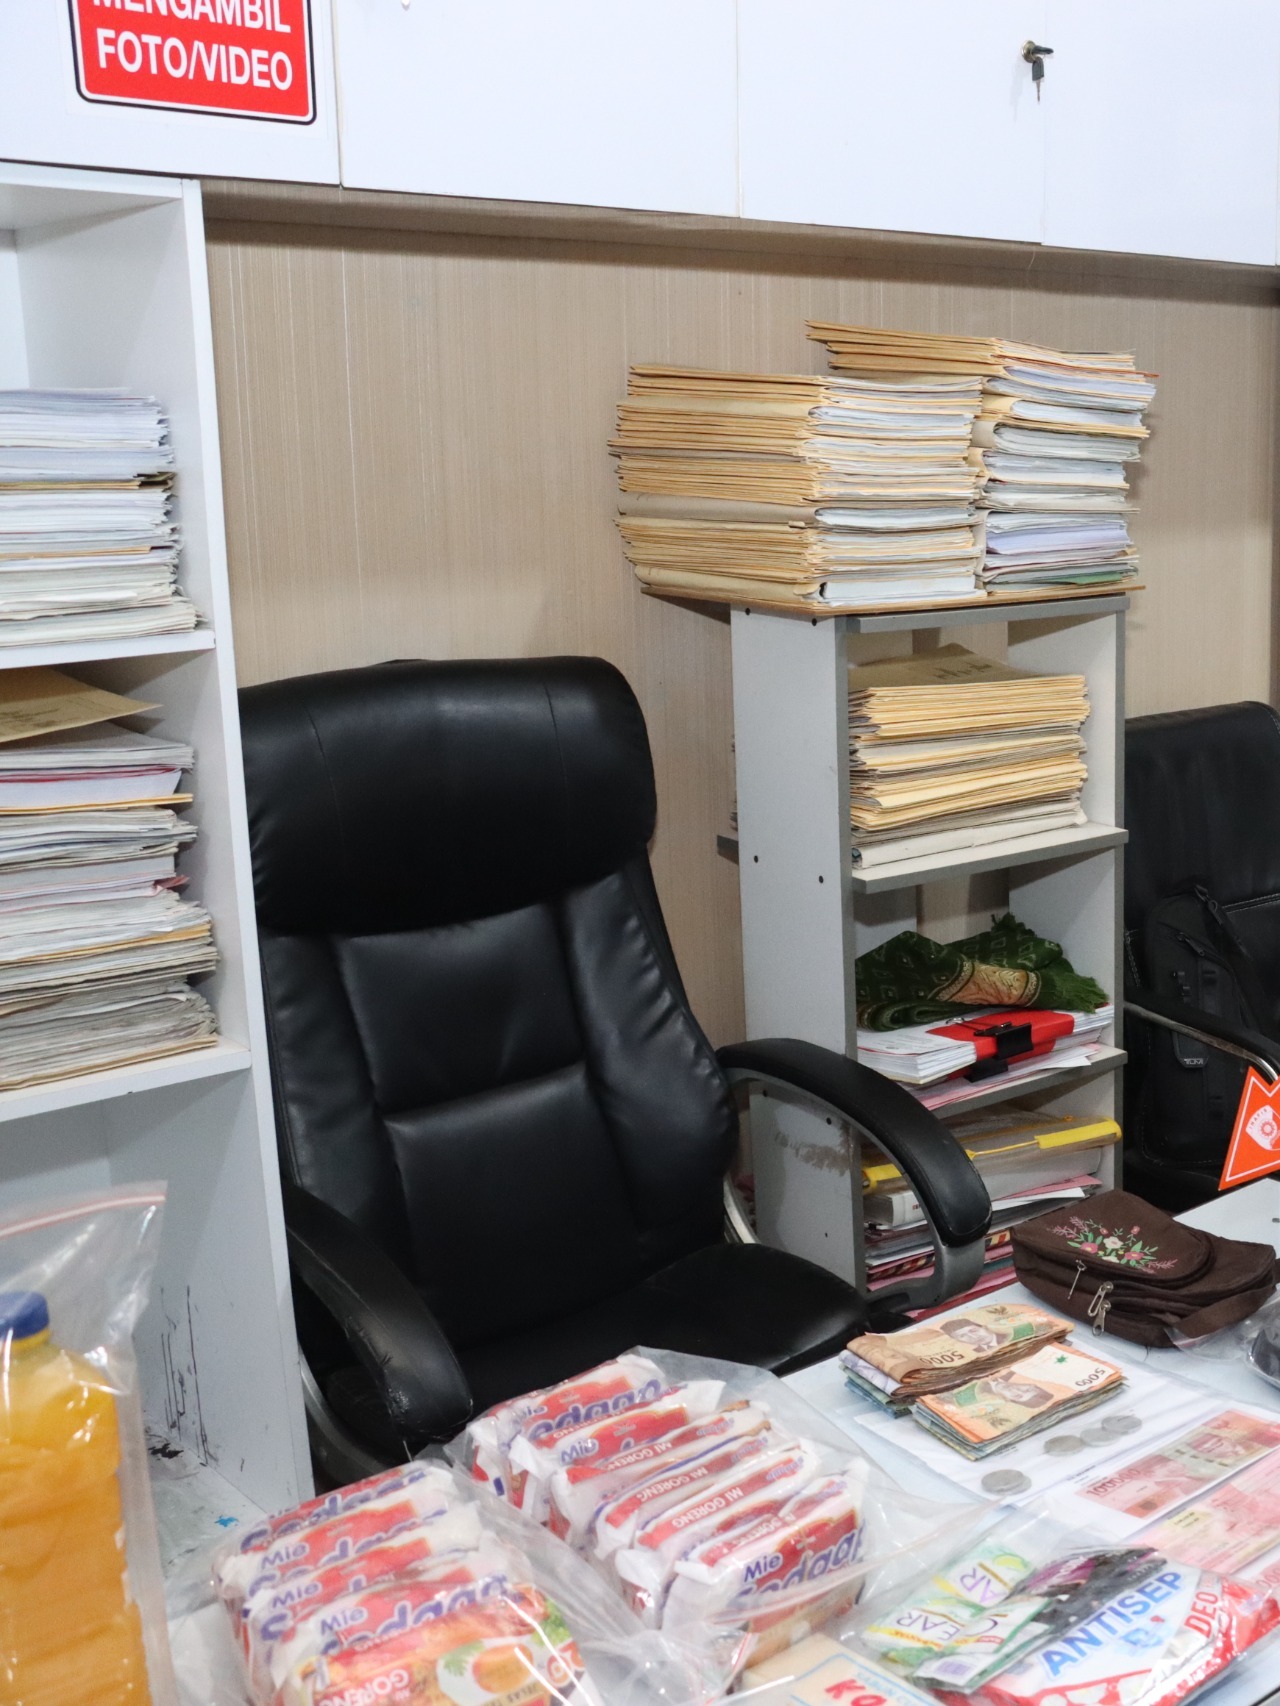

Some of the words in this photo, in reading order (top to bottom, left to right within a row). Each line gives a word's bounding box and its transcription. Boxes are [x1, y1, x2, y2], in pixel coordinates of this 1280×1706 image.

[93, 0, 291, 33] AMBIL
[97, 28, 292, 90] FOTO/VIDEO
[1075, 1367, 1106, 1387] 5000
[692, 1467, 709, 1480] MI
[636, 1475, 691, 1502] GORENG
[724, 1487, 744, 1502] MI
[672, 1499, 726, 1529] GORENG
[261, 1544, 307, 1570] Mie
[744, 1555, 781, 1583] Mie
[272, 1583, 320, 1609] Mie
[320, 1607, 365, 1636] Mie
[1041, 1572, 1182, 1676] ANTISEP
[1184, 1592, 1219, 1639] DEO
